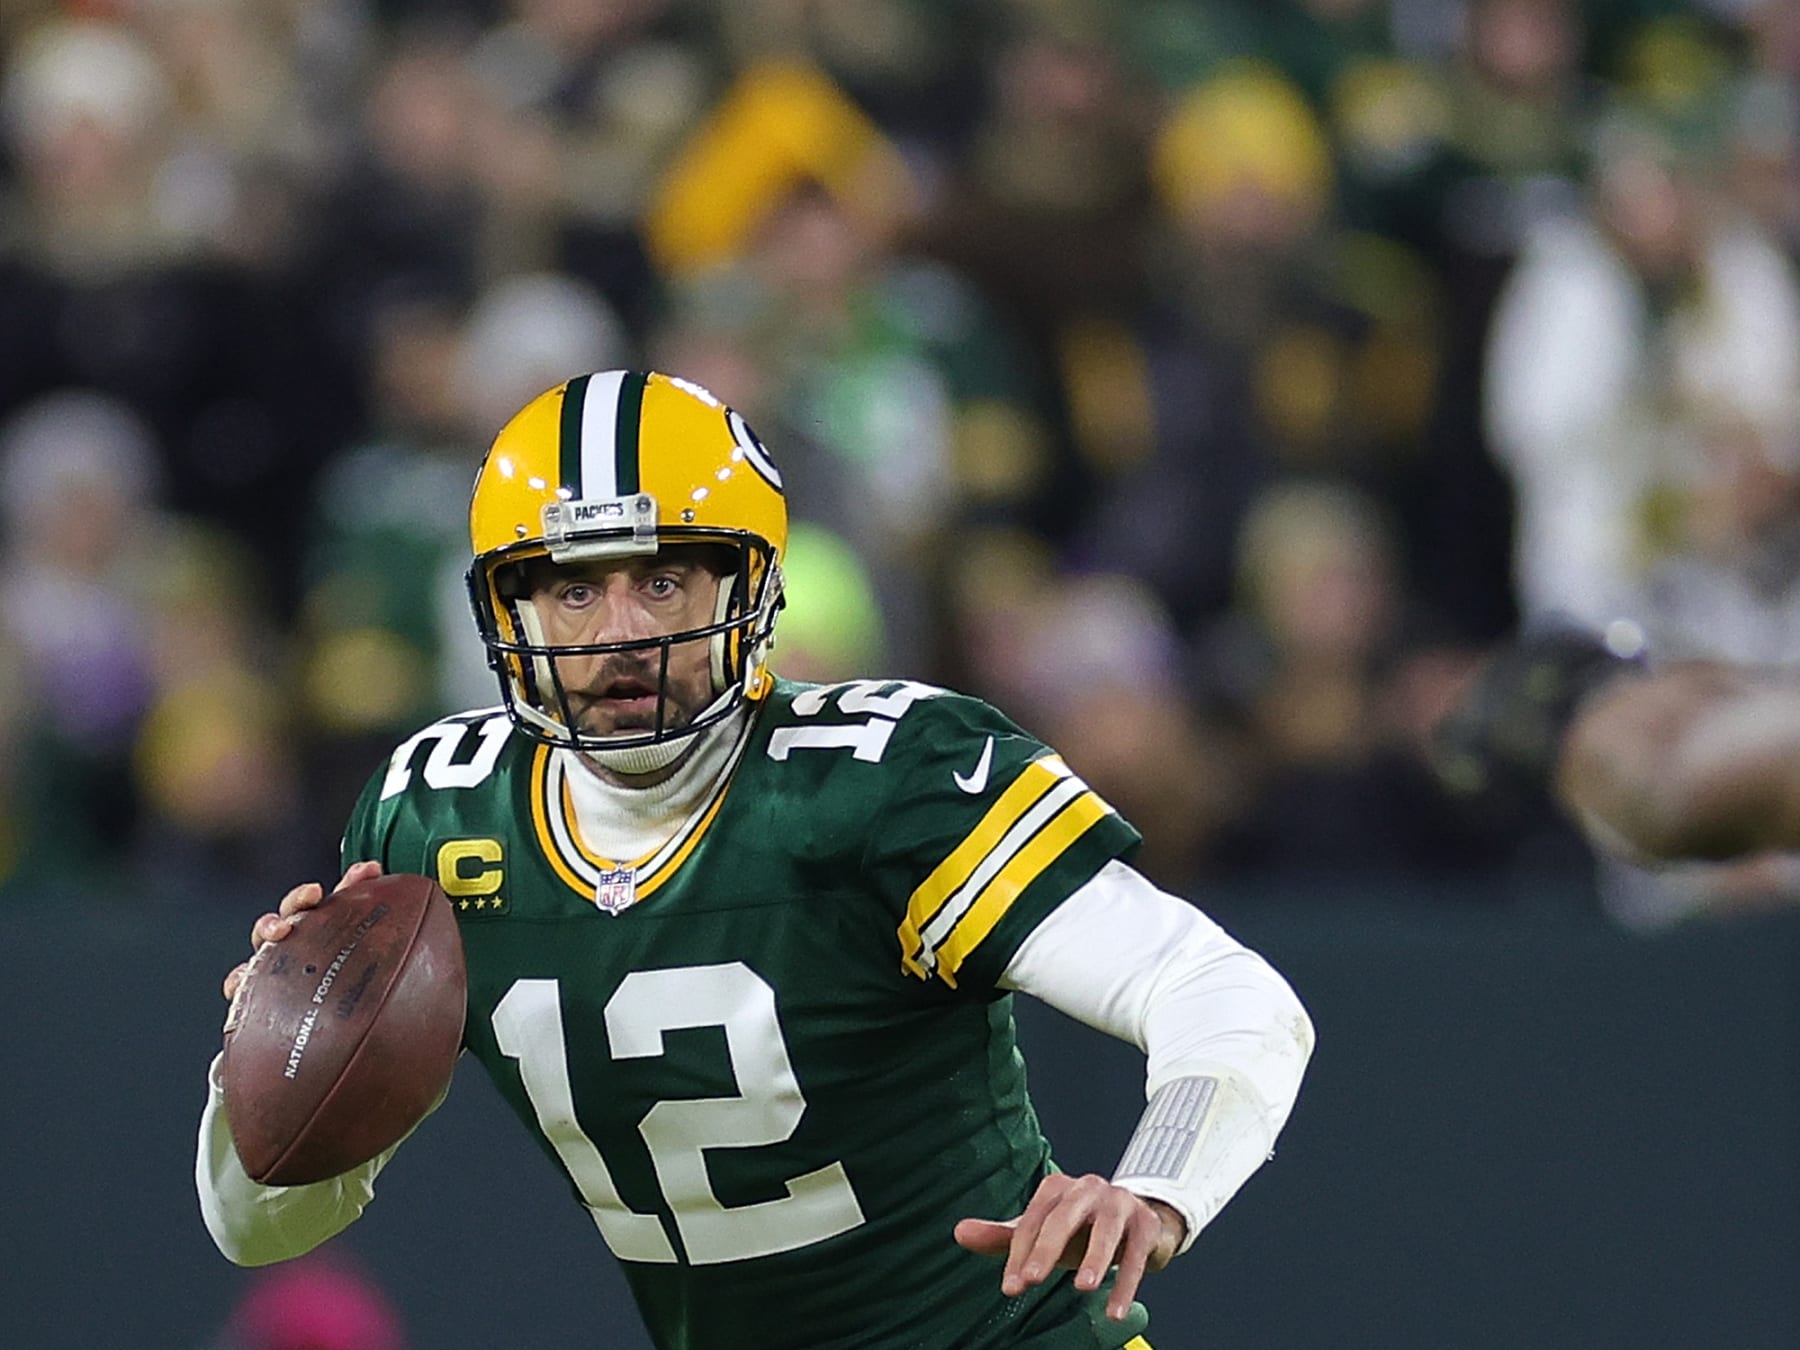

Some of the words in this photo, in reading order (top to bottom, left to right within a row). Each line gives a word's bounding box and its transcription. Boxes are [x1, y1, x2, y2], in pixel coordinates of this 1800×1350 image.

[574, 502, 624, 521] PACKES
[767, 679, 944, 763] 12
[437, 838, 503, 897] C
[284, 1007, 319, 1080] NATIONAL
[491, 961, 866, 1266] 12
